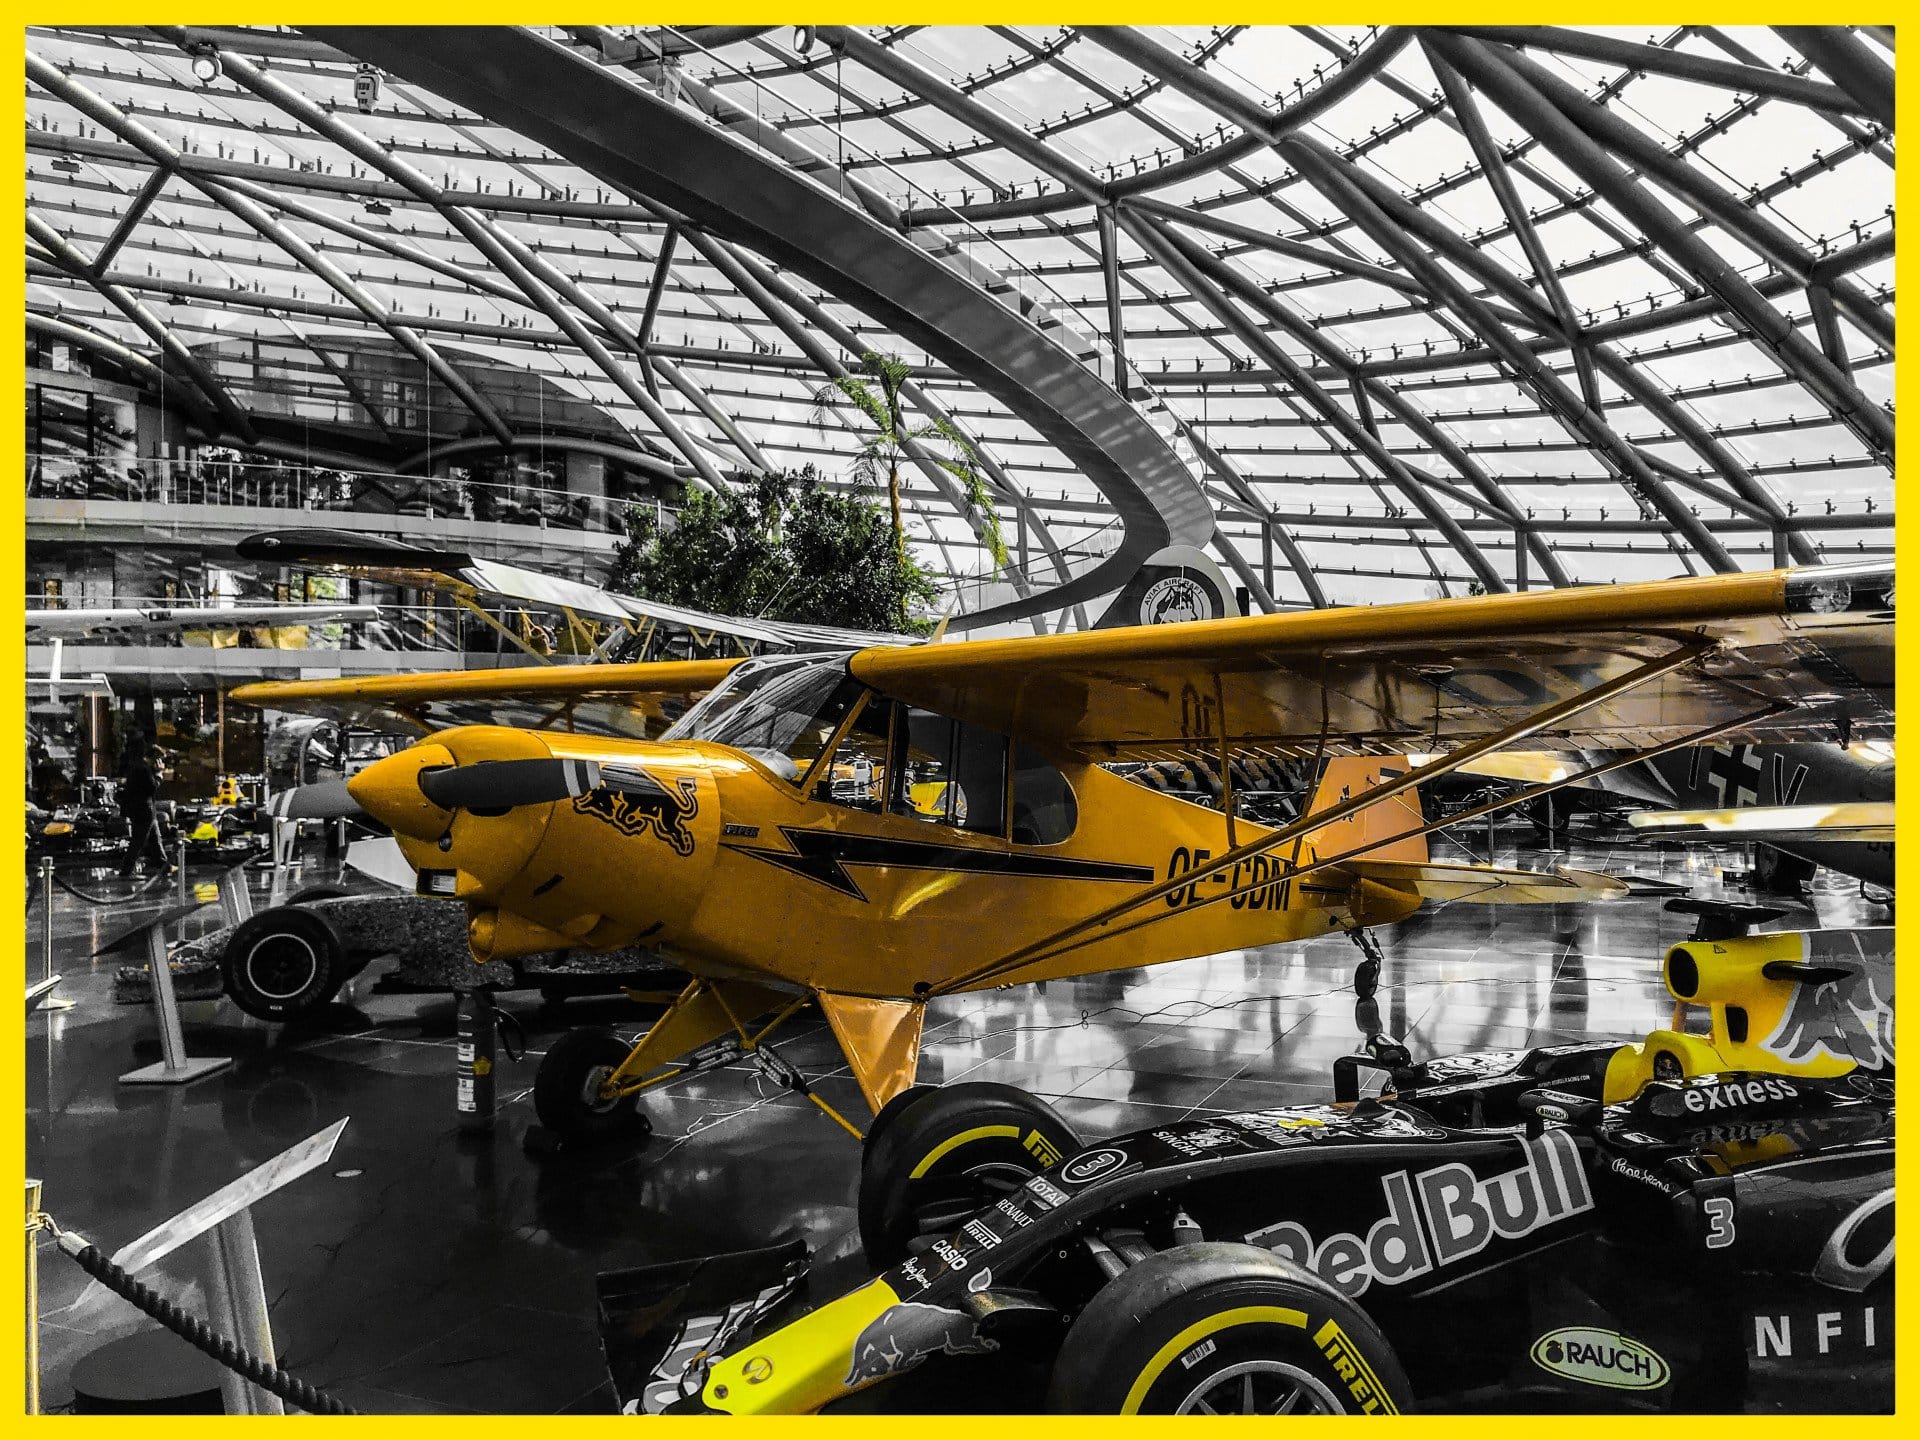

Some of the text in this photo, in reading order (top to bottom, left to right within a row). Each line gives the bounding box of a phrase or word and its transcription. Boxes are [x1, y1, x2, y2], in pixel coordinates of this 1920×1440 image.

[1144, 578, 1204, 606] AVIAT AIRCRAFT
[1165, 846, 1293, 912] OE-CDM
[1684, 1078, 1799, 1112] exness
[1544, 1108, 1565, 1119] RAUCH
[1152, 1131, 1203, 1157] SINGHA
[1071, 1152, 1115, 1178] 3
[1029, 1176, 1065, 1208] TOTAL
[996, 1198, 1035, 1228] RENAULT
[1704, 1197, 1736, 1249] 3
[963, 1219, 1003, 1250] PIRELLI
[931, 1239, 968, 1271] CASIO
[1566, 1341, 1651, 1380] RAUCH
